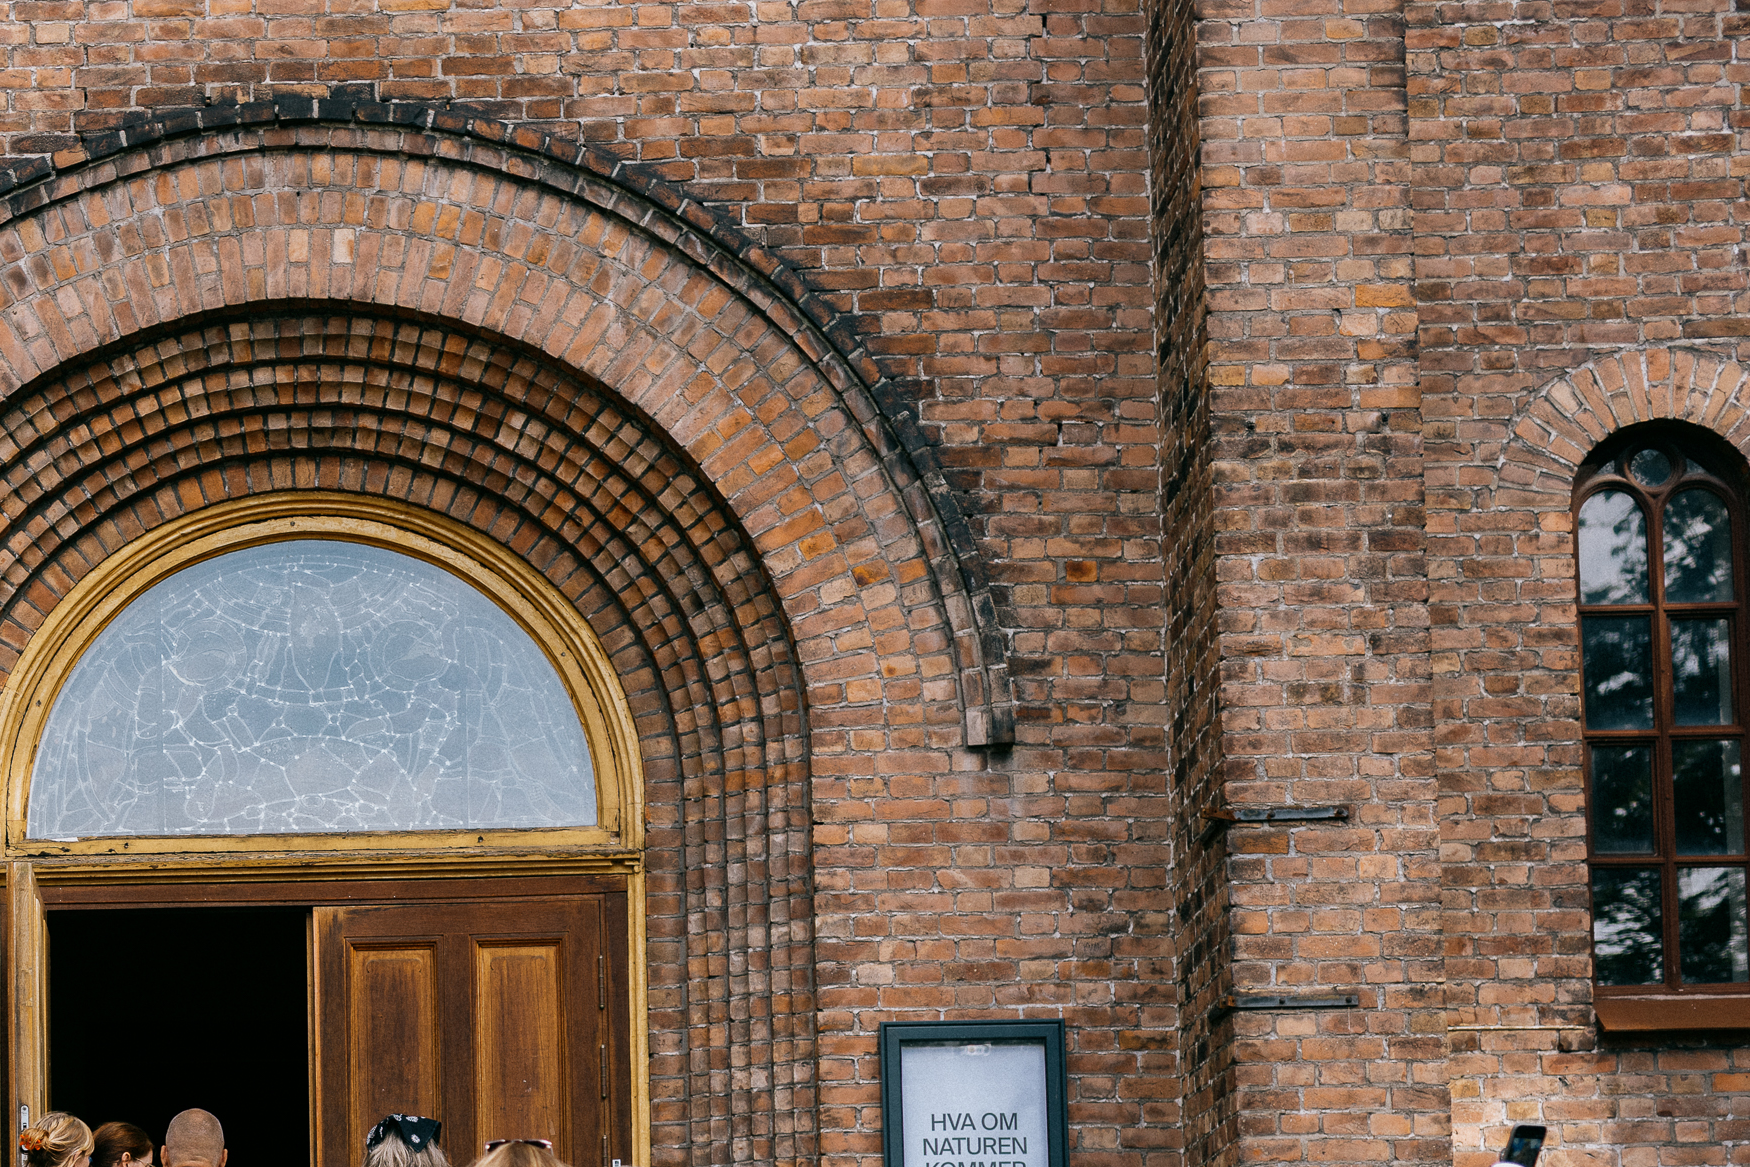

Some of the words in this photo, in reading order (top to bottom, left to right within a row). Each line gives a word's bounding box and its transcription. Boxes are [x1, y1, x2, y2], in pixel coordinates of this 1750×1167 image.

[931, 1113, 976, 1131] HVA
[981, 1112, 1018, 1130] OM
[923, 1136, 1027, 1156] NATUREN
